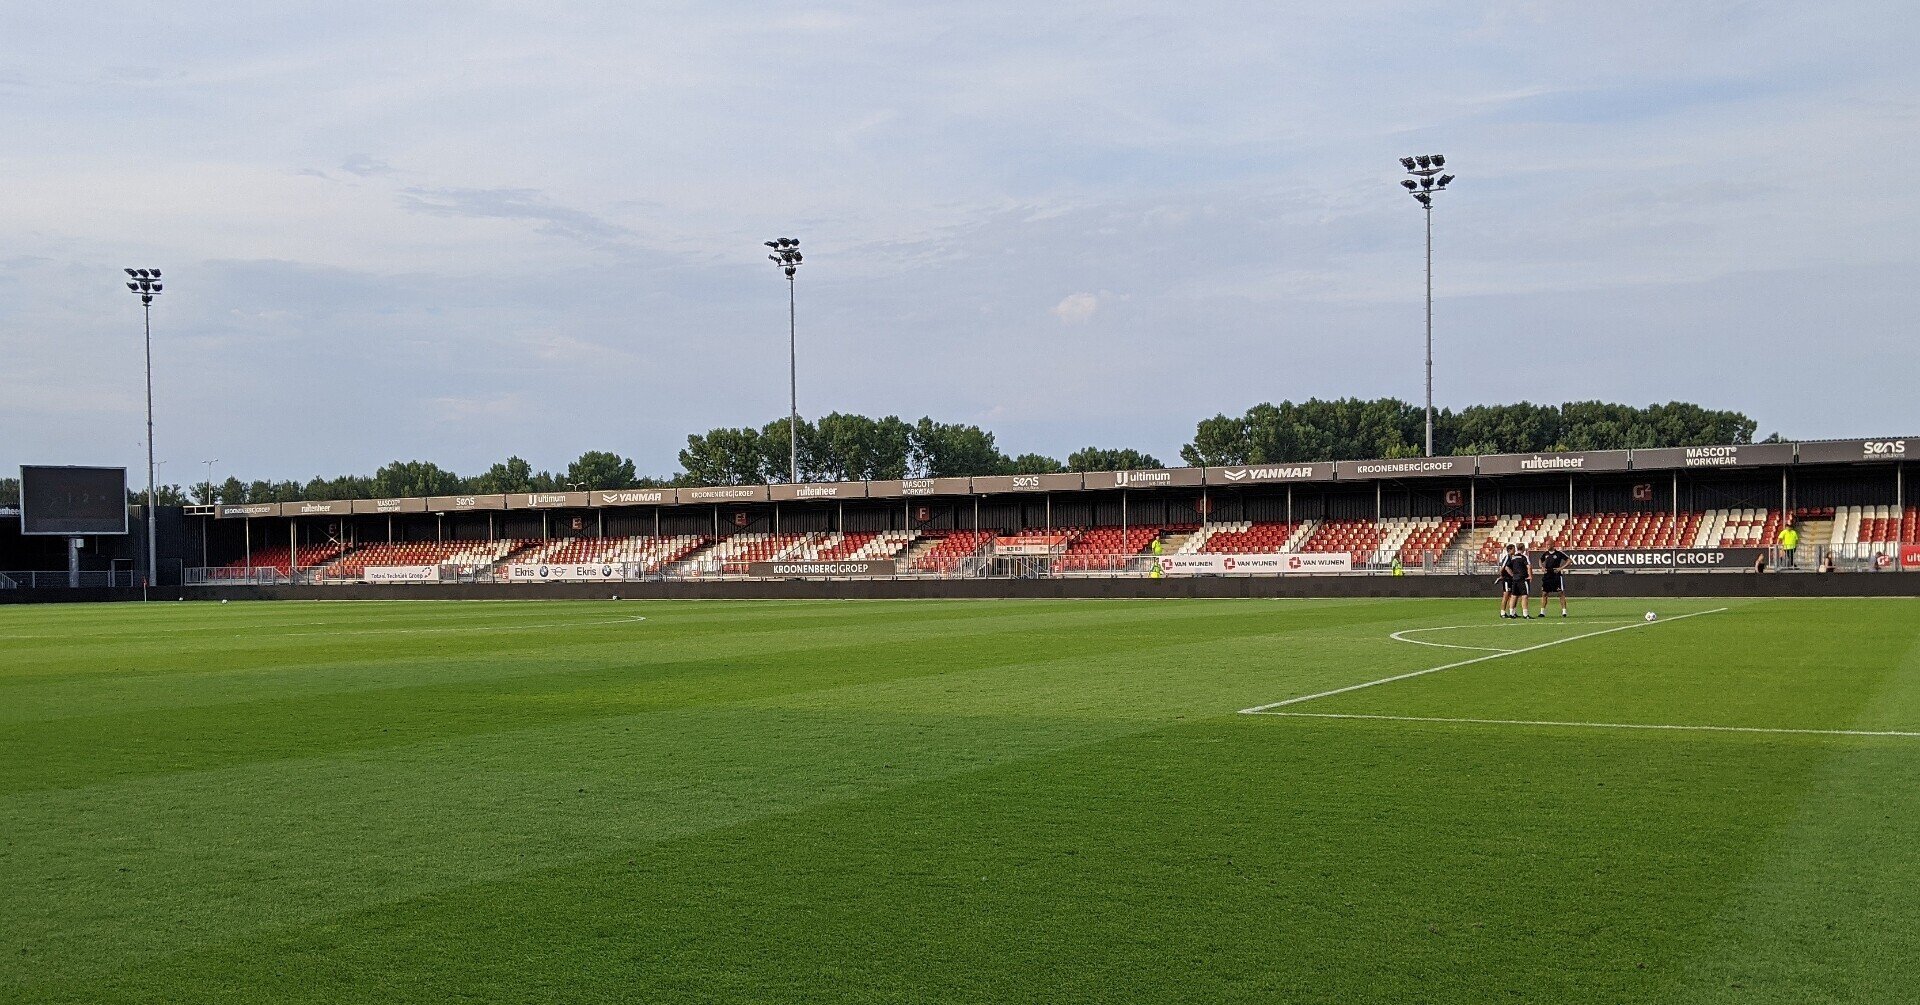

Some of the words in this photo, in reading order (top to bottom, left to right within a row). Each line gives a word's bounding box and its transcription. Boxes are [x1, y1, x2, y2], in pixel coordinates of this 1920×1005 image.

[1521, 454, 1584, 469] ruitenheer
[1686, 456, 1737, 466] WORKWEAR
[1130, 471, 1170, 482] ultimum
[1249, 467, 1313, 480] YANMAR
[796, 485, 838, 497] ruitenheer
[538, 494, 566, 502] ultimum
[620, 492, 662, 502] YANMAR
[302, 504, 331, 514] ruitenheer
[920, 508, 926, 518] F
[514, 568, 534, 576] Ekris
[576, 566, 596, 576] Ekris
